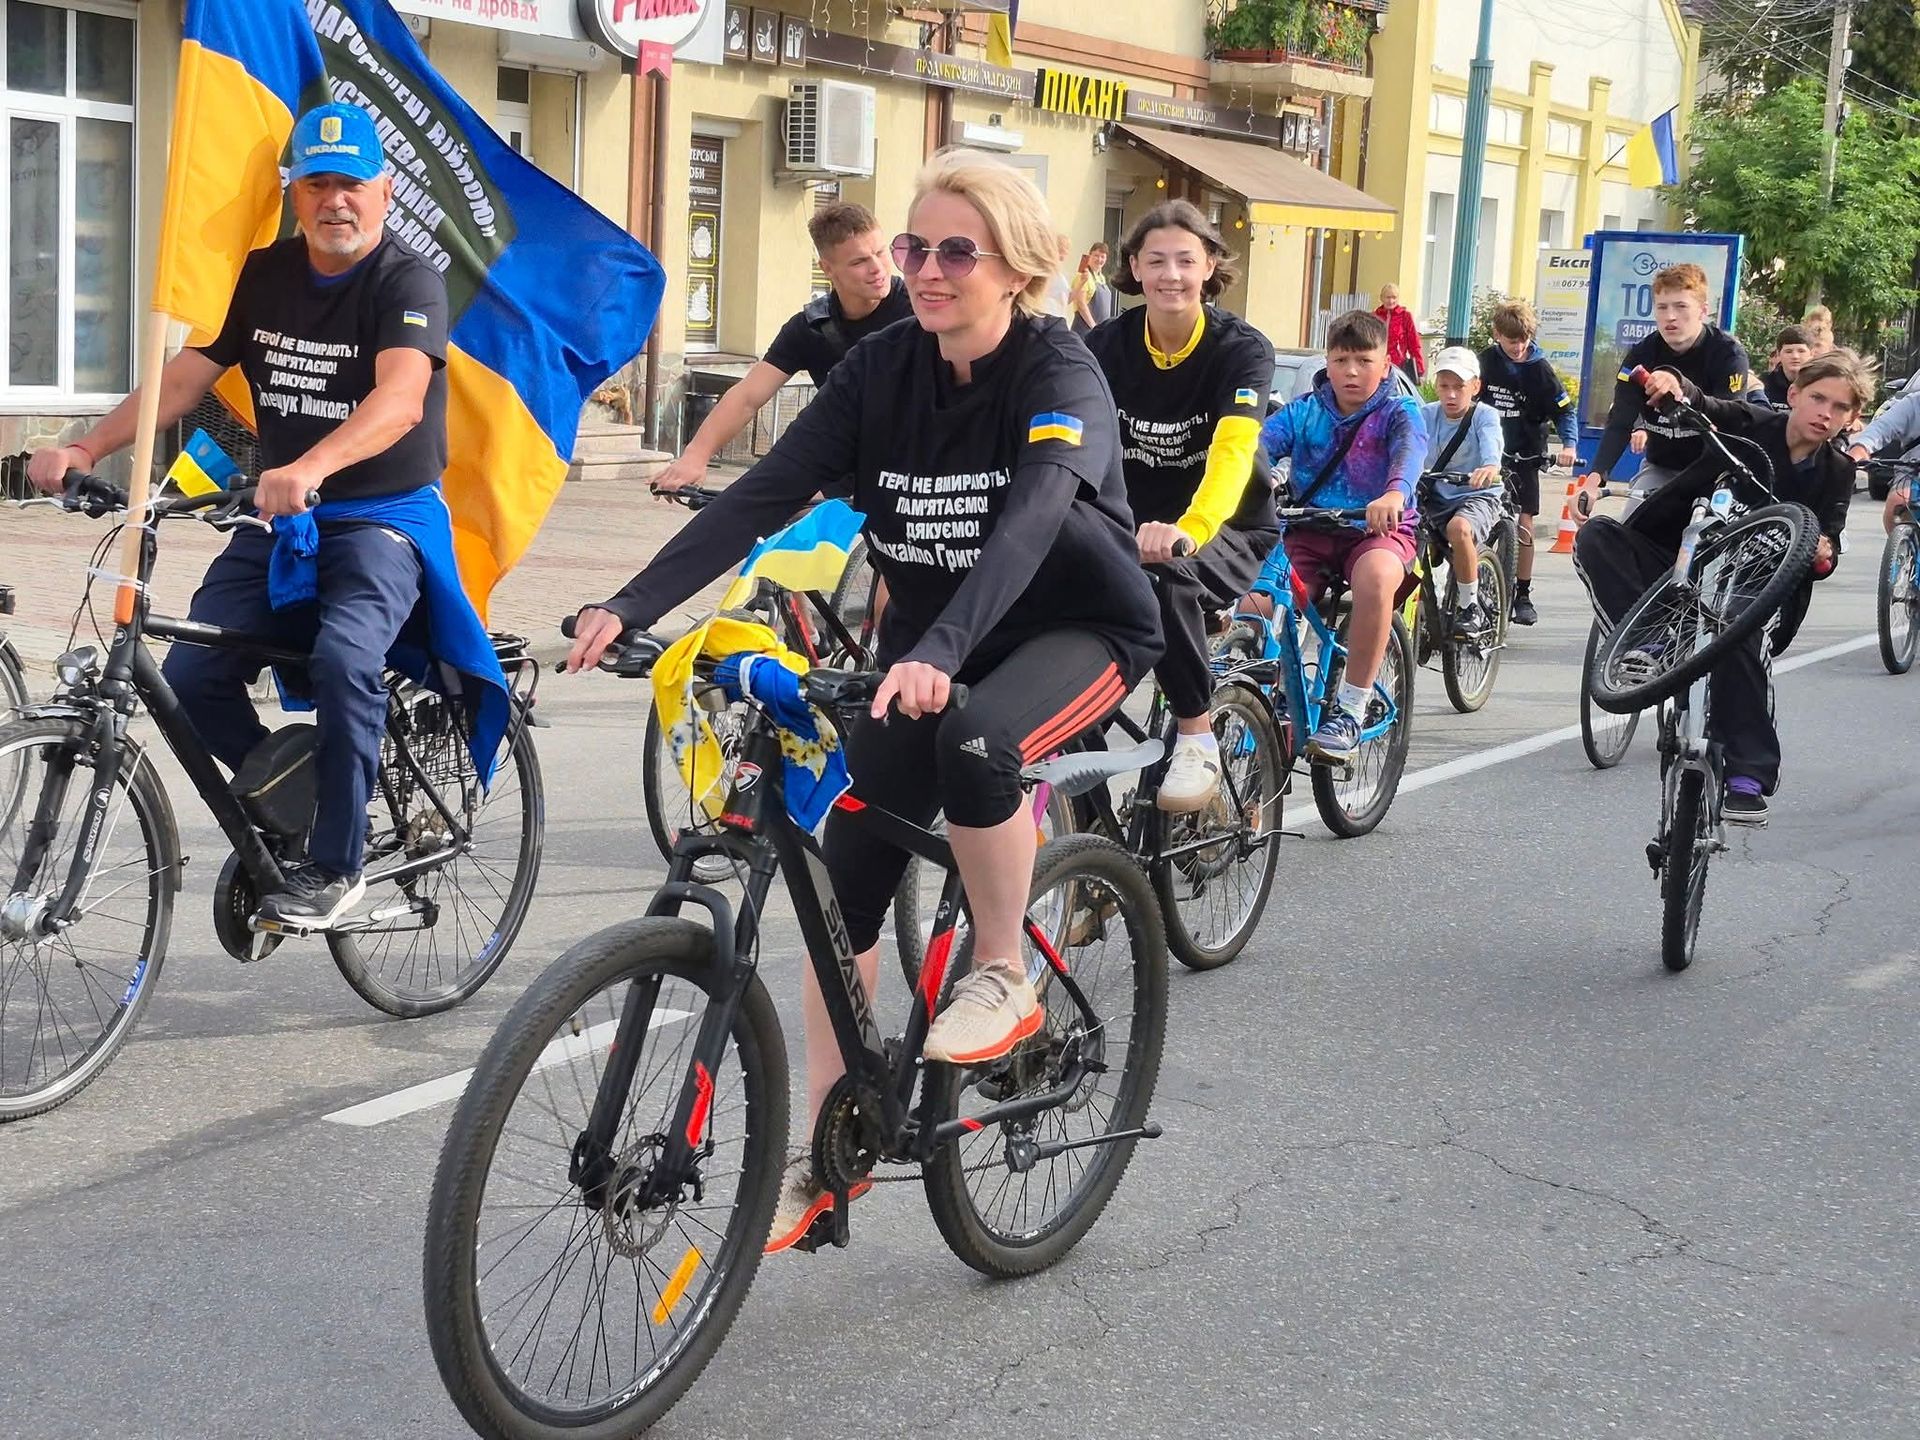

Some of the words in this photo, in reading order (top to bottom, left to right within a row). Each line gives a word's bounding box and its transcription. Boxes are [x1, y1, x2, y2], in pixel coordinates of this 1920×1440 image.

[1041, 68, 1129, 122] ПІКАНТ
[305, 144, 360, 156] UKRAINE
[1549, 256, 1591, 268] Експ
[253, 328, 282, 347] ГЕРОЇ
[280, 336, 297, 351] НЕ
[270, 370, 327, 392] ДЯКУЄМО!
[301, 394, 349, 420] Микола
[1135, 420, 1151, 432] НЕ
[1123, 447, 1155, 468] ихайло
[912, 476, 932, 494] НЕ
[906, 520, 980, 541] ДЯКУЄМО!
[959, 743, 988, 759] adidas
[824, 897, 875, 1043] SPARK
